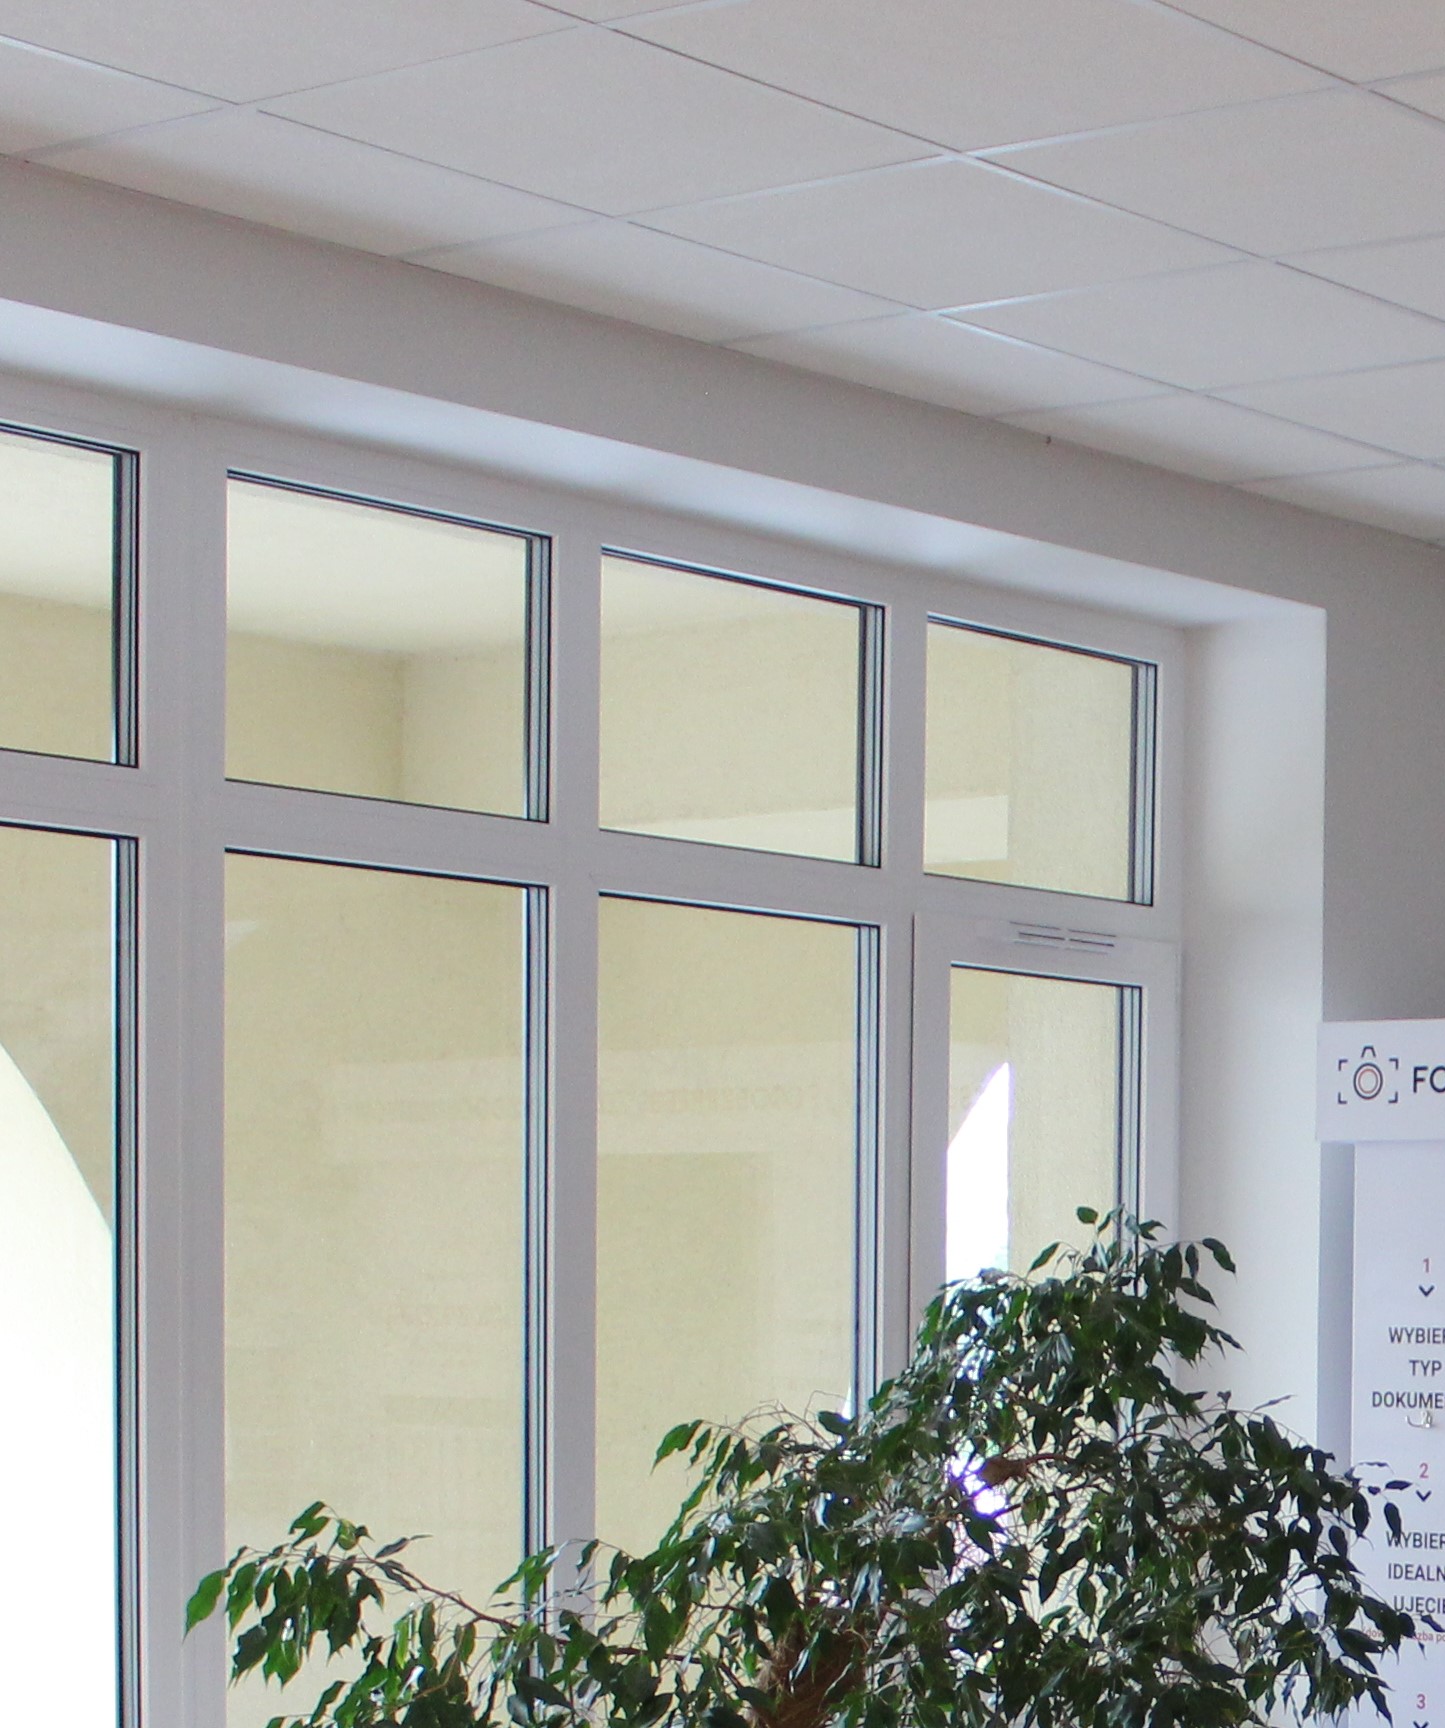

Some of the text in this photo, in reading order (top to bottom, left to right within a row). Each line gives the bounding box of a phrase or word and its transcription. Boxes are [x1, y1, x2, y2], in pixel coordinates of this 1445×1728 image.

[1423, 1258, 1429, 1273] 1
[1409, 1360, 1442, 1376] TYP
[1420, 1463, 1428, 1479] 2
[1417, 1694, 1426, 1710] 3
